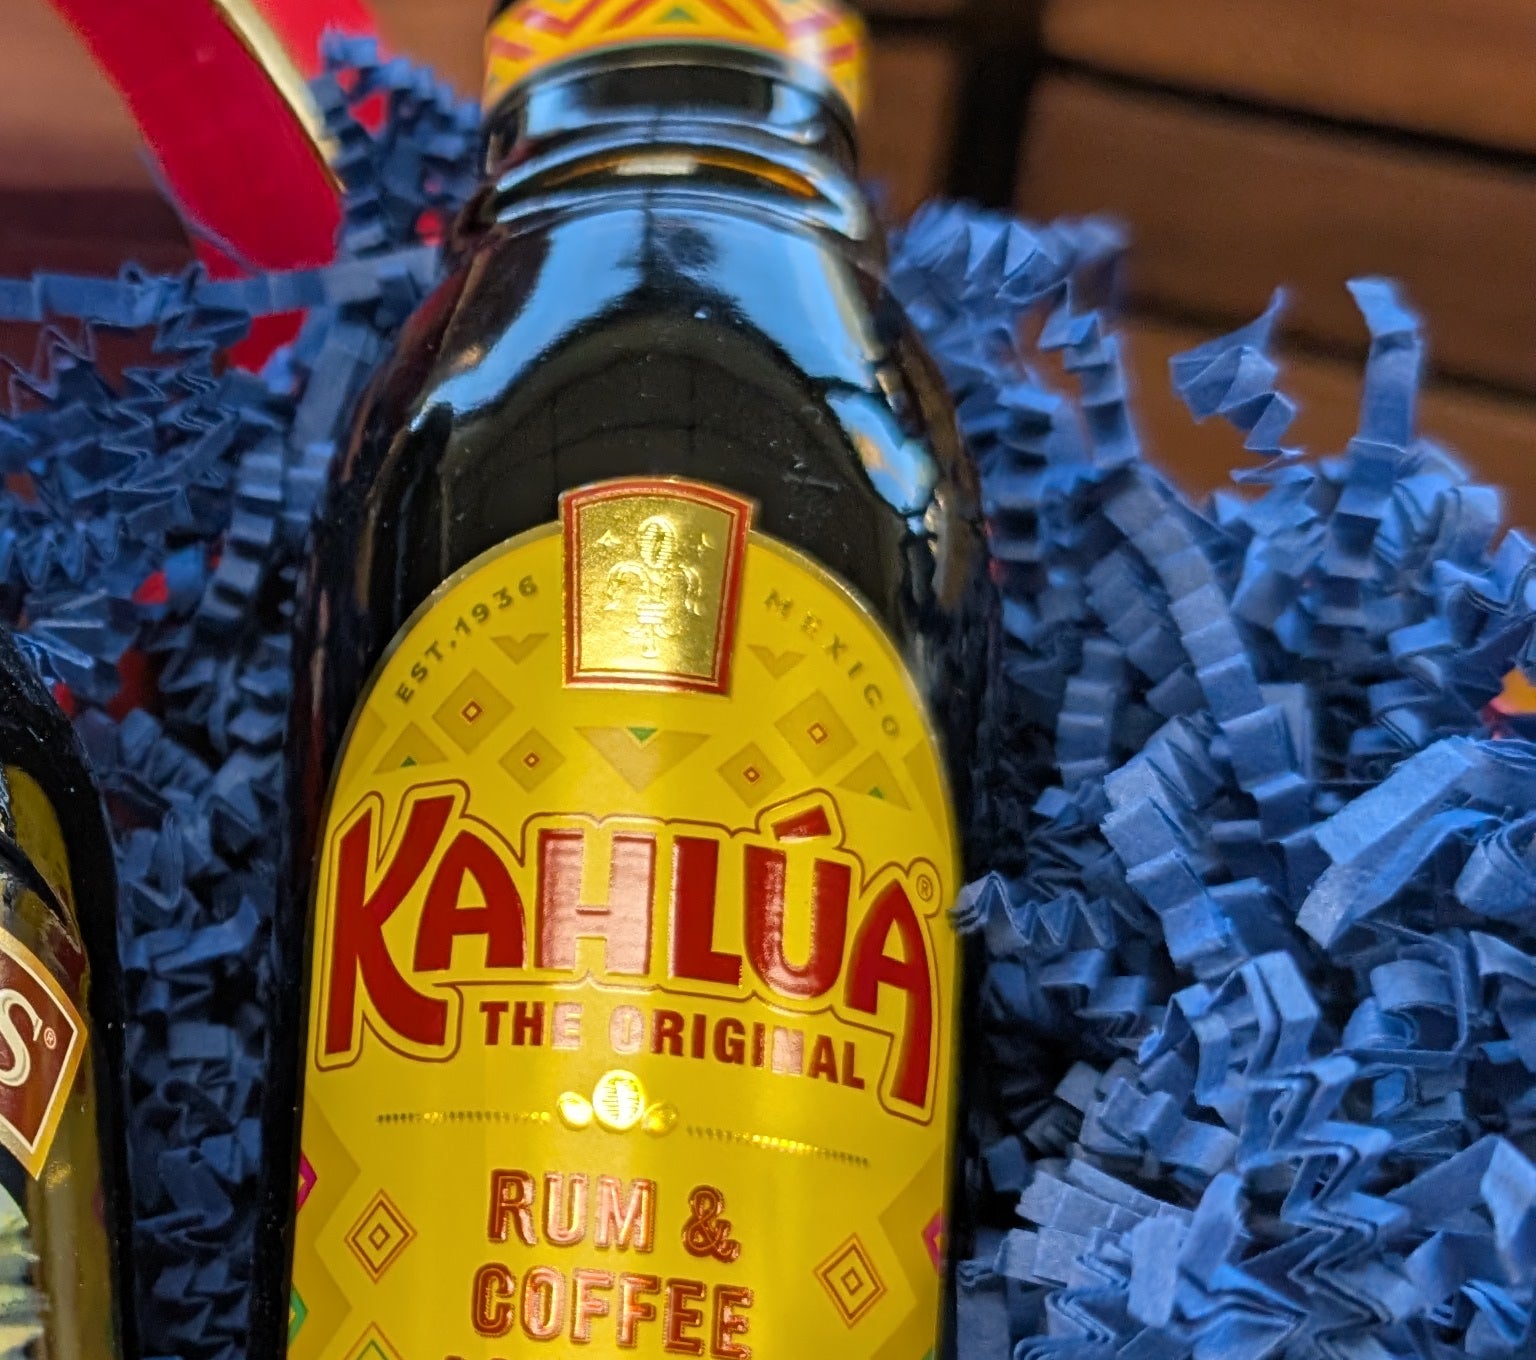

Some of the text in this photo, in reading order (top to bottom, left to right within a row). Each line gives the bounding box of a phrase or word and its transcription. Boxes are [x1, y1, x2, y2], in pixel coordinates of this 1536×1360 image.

[764, 589, 900, 738] MEXICO
[324, 794, 933, 1111] KAHLÚA
[478, 1000, 865, 1090] THE ORIGINAL
[488, 1168, 741, 1263] RUM &
